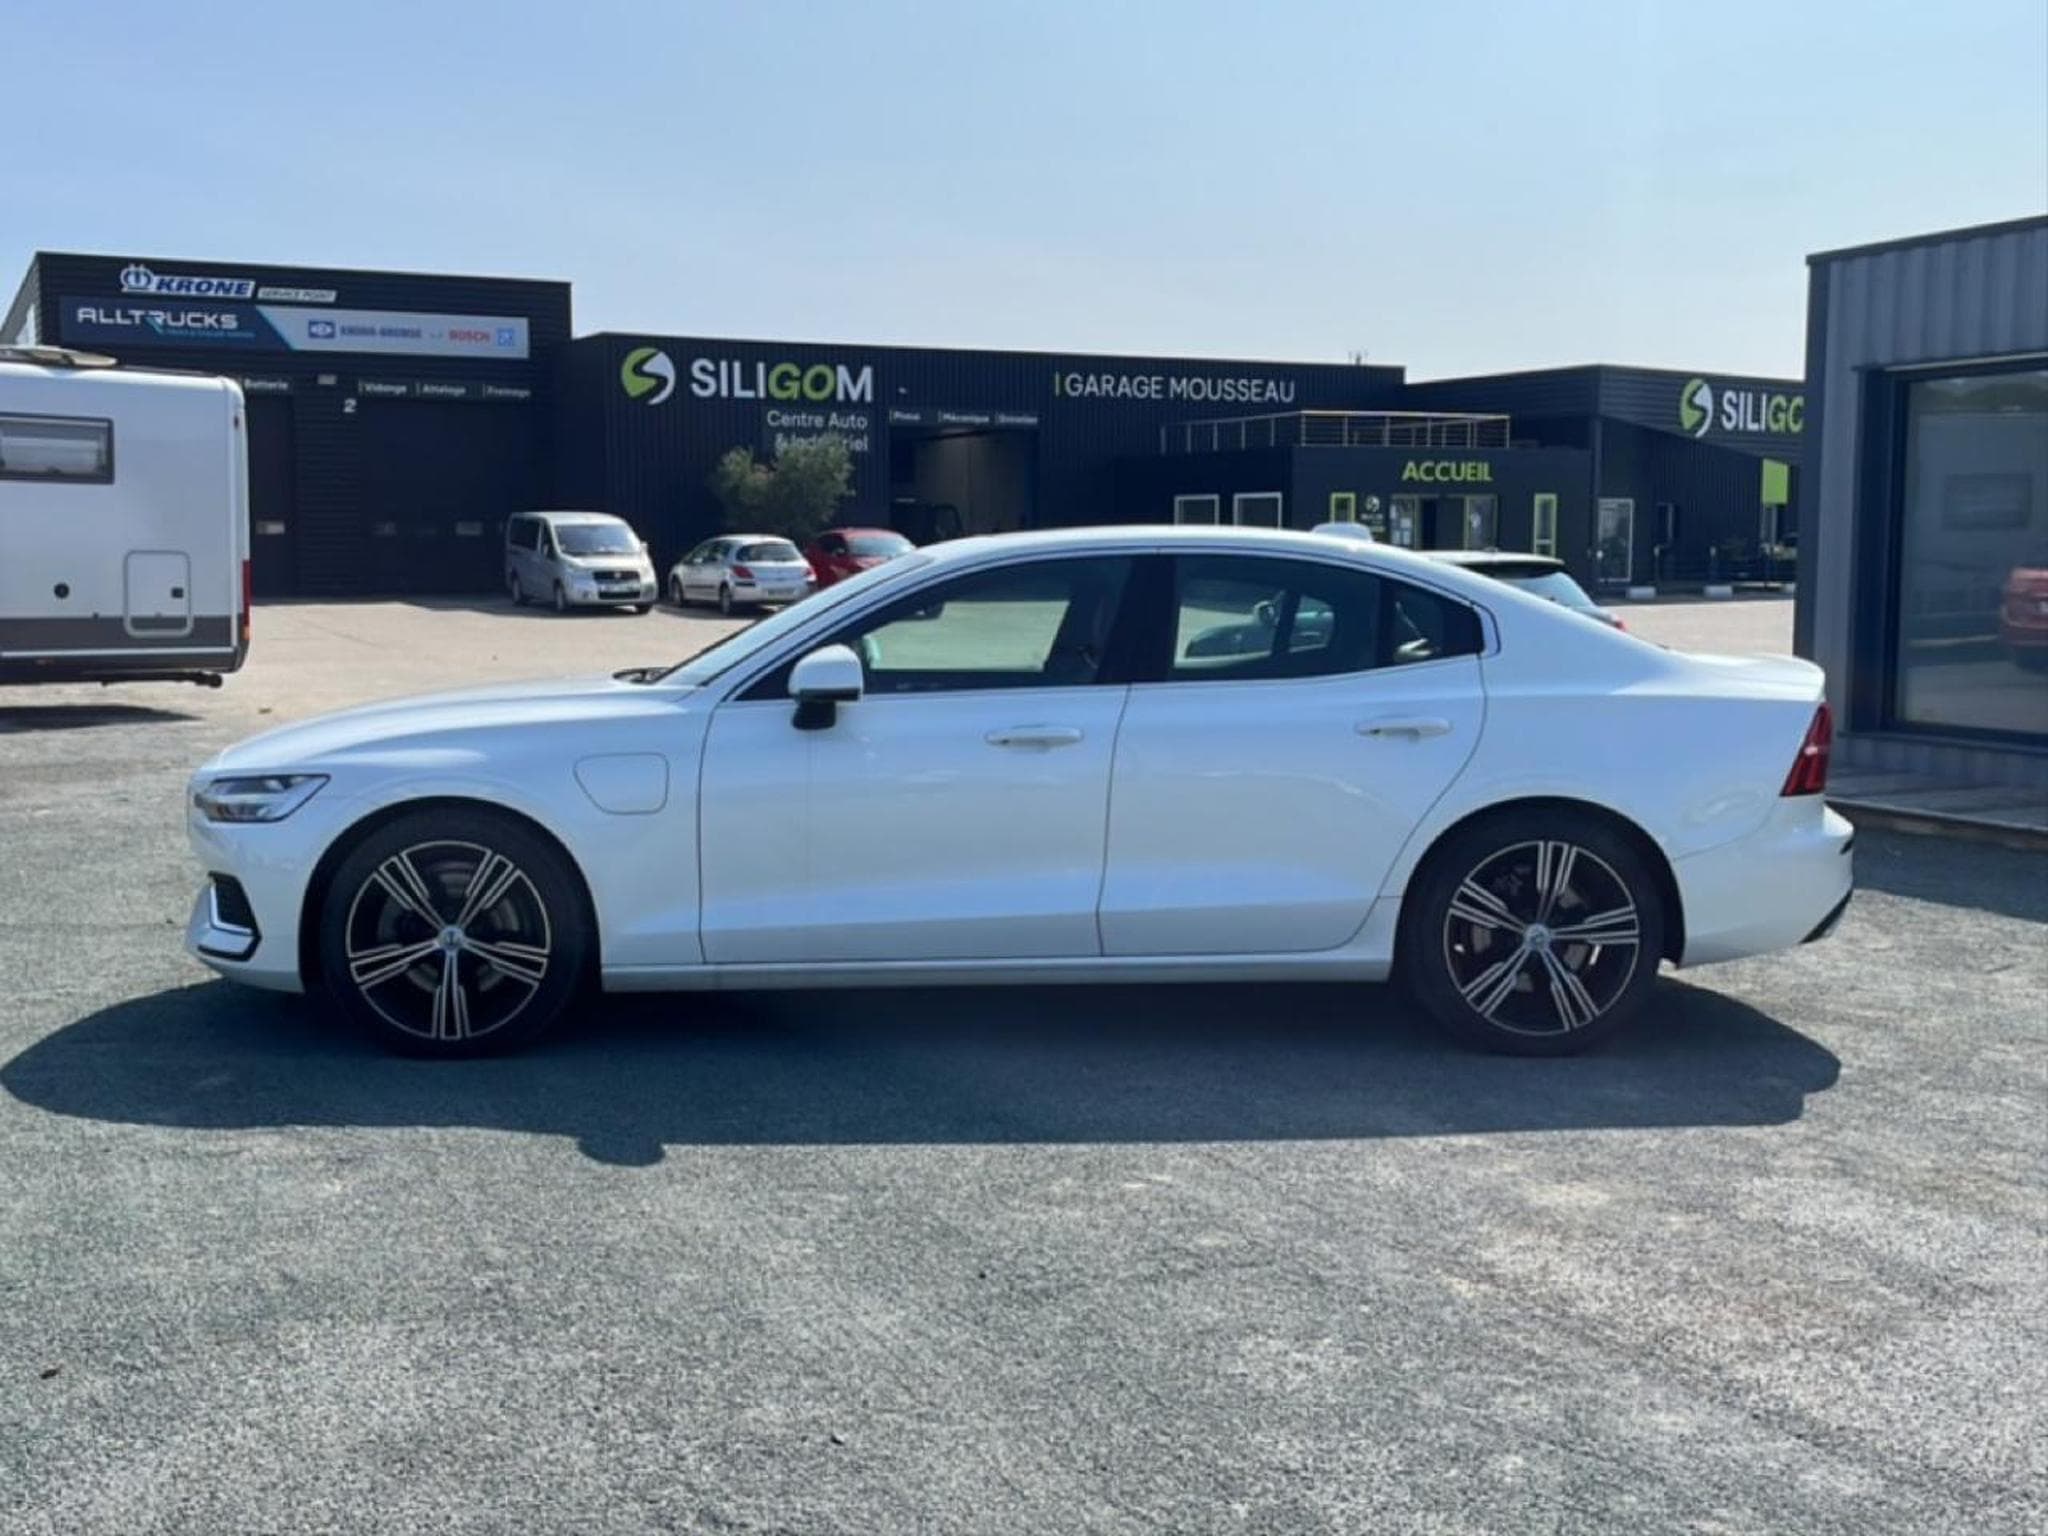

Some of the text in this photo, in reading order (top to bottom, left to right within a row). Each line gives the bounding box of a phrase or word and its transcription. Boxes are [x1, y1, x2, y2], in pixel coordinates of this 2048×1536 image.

[156, 277, 250, 296] KRONE
[77, 307, 238, 330] ALLTRUCKS
[690, 358, 873, 403] SILIGOM
[1064, 372, 1296, 403] GARAGE MOUSSEAU
[343, 398, 357, 413] 2
[766, 410, 869, 430] Centre Auto
[1401, 461, 1493, 481] ACCUEIL
